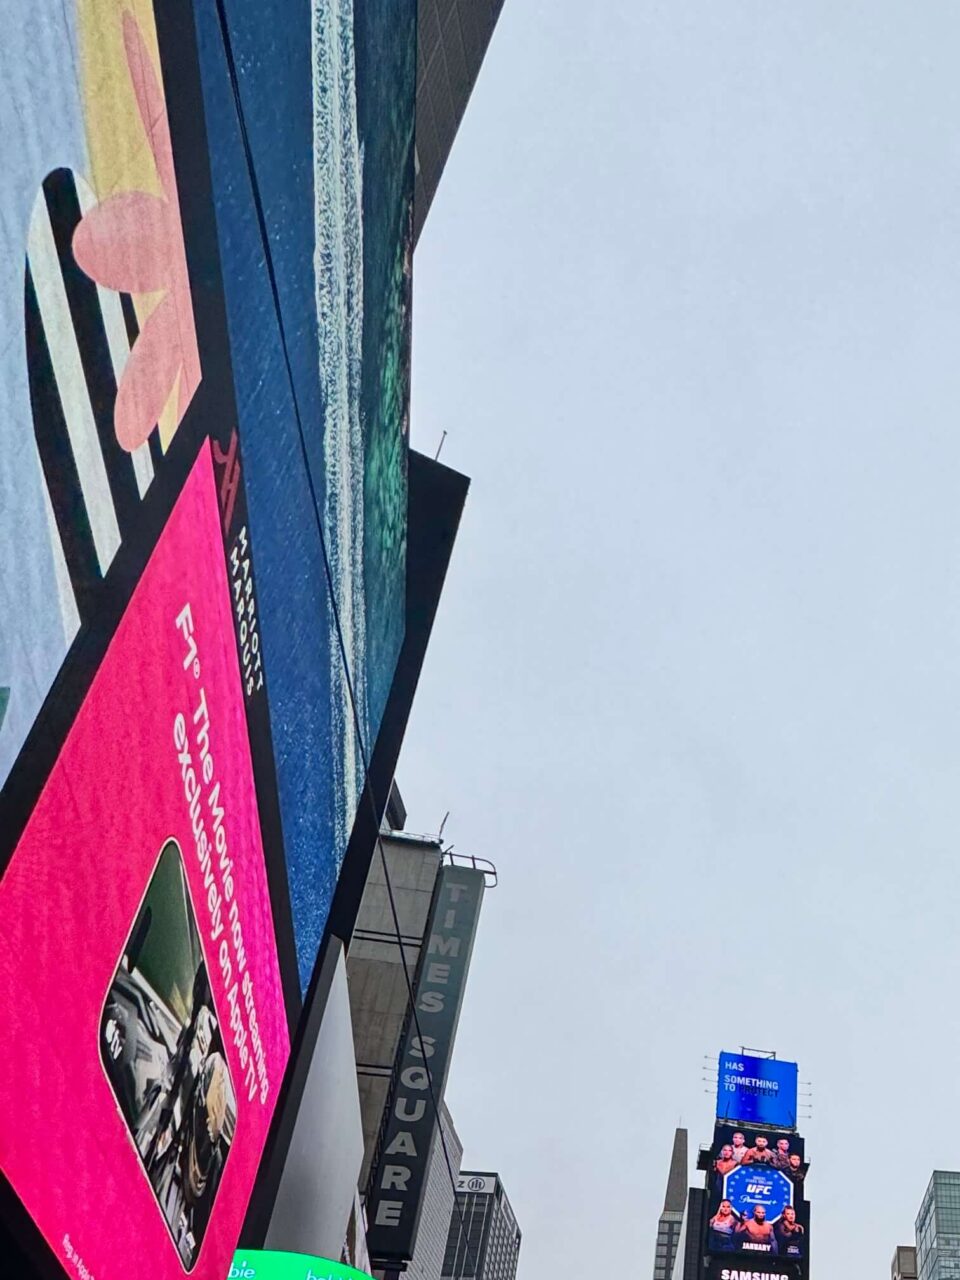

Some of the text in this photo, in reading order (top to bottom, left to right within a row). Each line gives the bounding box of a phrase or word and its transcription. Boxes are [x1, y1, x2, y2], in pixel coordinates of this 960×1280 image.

[230, 546, 254, 696] MARQUIS
[239, 526, 265, 691] MARRIOTT
[173, 712, 257, 1102] exclusively on Apple TV
[193, 687, 214, 785] The
[208, 781, 234, 902] Movie
[229, 899, 247, 973] now
[242, 970, 269, 1105] streaming
[375, 882, 468, 1227] TIMES SQUARE
[723, 1083, 736, 1091] TO
[724, 1074, 779, 1090] SOMETHING
[725, 1061, 745, 1072] HAS
[746, 1184, 772, 1195] UFC
[742, 1242, 771, 1252] JANUARY
